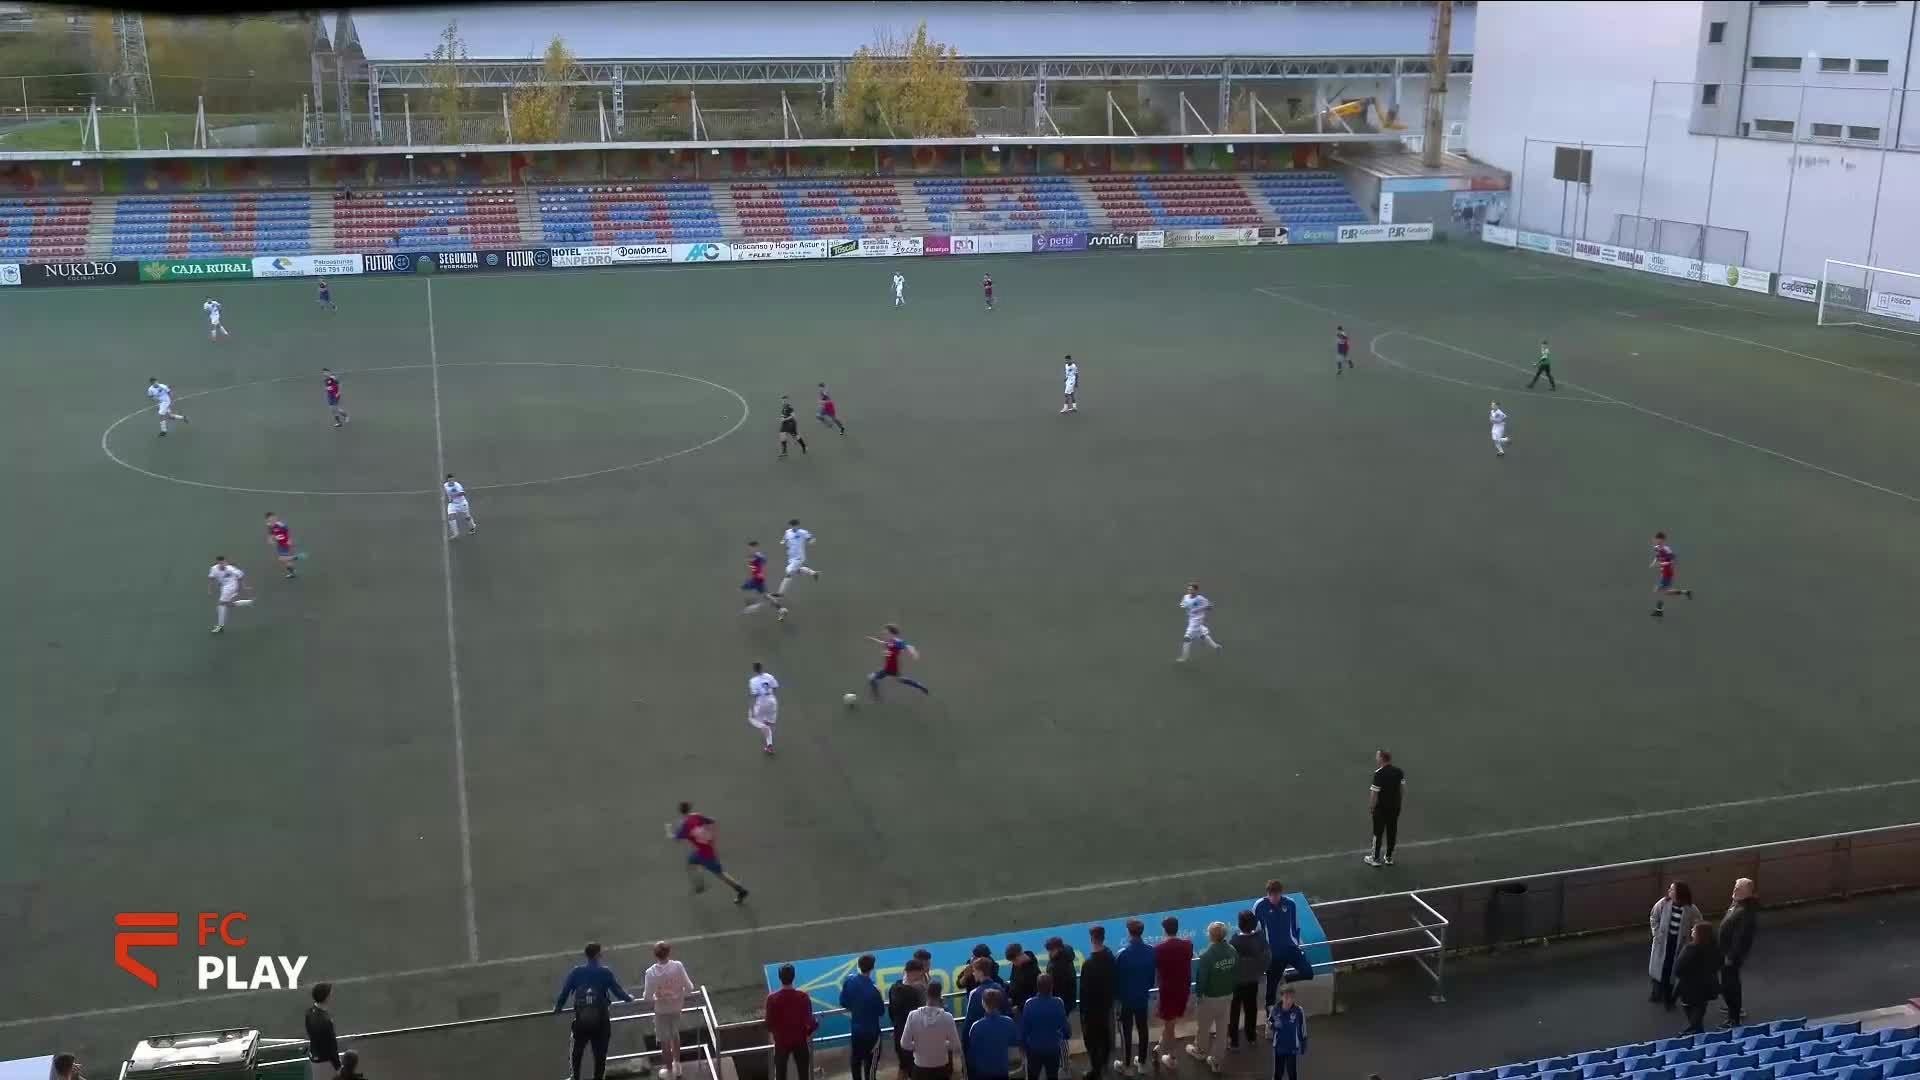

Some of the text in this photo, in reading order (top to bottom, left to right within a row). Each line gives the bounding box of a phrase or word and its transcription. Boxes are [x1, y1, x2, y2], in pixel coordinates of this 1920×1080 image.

[552, 248, 581, 256] HOTEL
[733, 242, 768, 250] Descanso
[776, 242, 798, 251] Hogar
[799, 241, 820, 249] Astur
[439, 252, 478, 264] SEGUNDA
[44, 261, 117, 277] NUKLEO
[171, 262, 250, 274] CAJA RURAL
